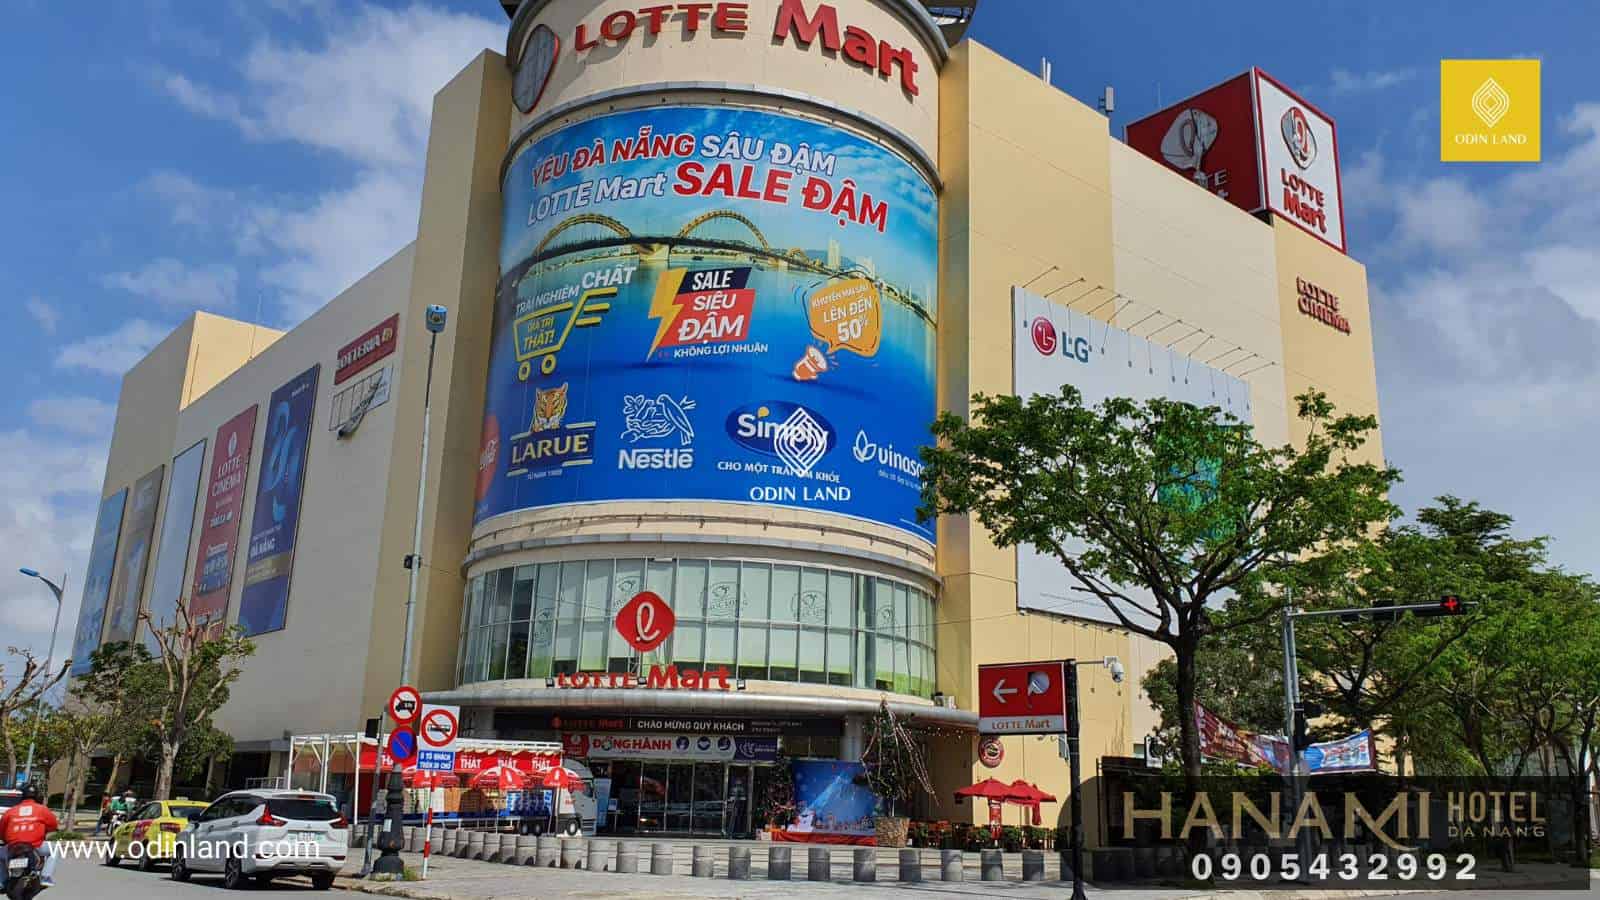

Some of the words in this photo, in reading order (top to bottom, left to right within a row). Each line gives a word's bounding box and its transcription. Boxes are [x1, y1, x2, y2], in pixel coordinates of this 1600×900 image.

[574, 2, 748, 51] LOTTE
[775, 0, 919, 97] Mart
[532, 153, 568, 187] YÊU
[572, 139, 605, 171] ĐÀ
[610, 125, 695, 163] NẴNG
[700, 131, 764, 161] SÂU
[770, 142, 836, 177] ĐẬM
[527, 180, 593, 226] LOTTE
[594, 173, 667, 202] Mart
[673, 161, 793, 204] SALE
[801, 176, 888, 233] ĐẬM
[1281, 168, 1325, 207] LOTTE
[1284, 187, 1327, 234] Mart
[692, 270, 734, 291] SALE
[693, 290, 736, 312] SIÊU
[824, 304, 847, 323] LÊN
[678, 311, 745, 345] ĐẬM
[674, 345, 711, 358] KHÔNG
[713, 345, 730, 356] LỢI
[732, 342, 768, 356] NHUẬN
[1062, 331, 1089, 363] LG
[511, 434, 589, 464] LARUE
[717, 461, 741, 471] CHO
[557, 671, 637, 689] LOTTE
[647, 664, 730, 691] Mart
[638, 719, 662, 729] CHÀO
[713, 719, 745, 731] KHÁCH
[992, 720, 1022, 730] LOTTE
[1025, 718, 1051, 729] Mart
